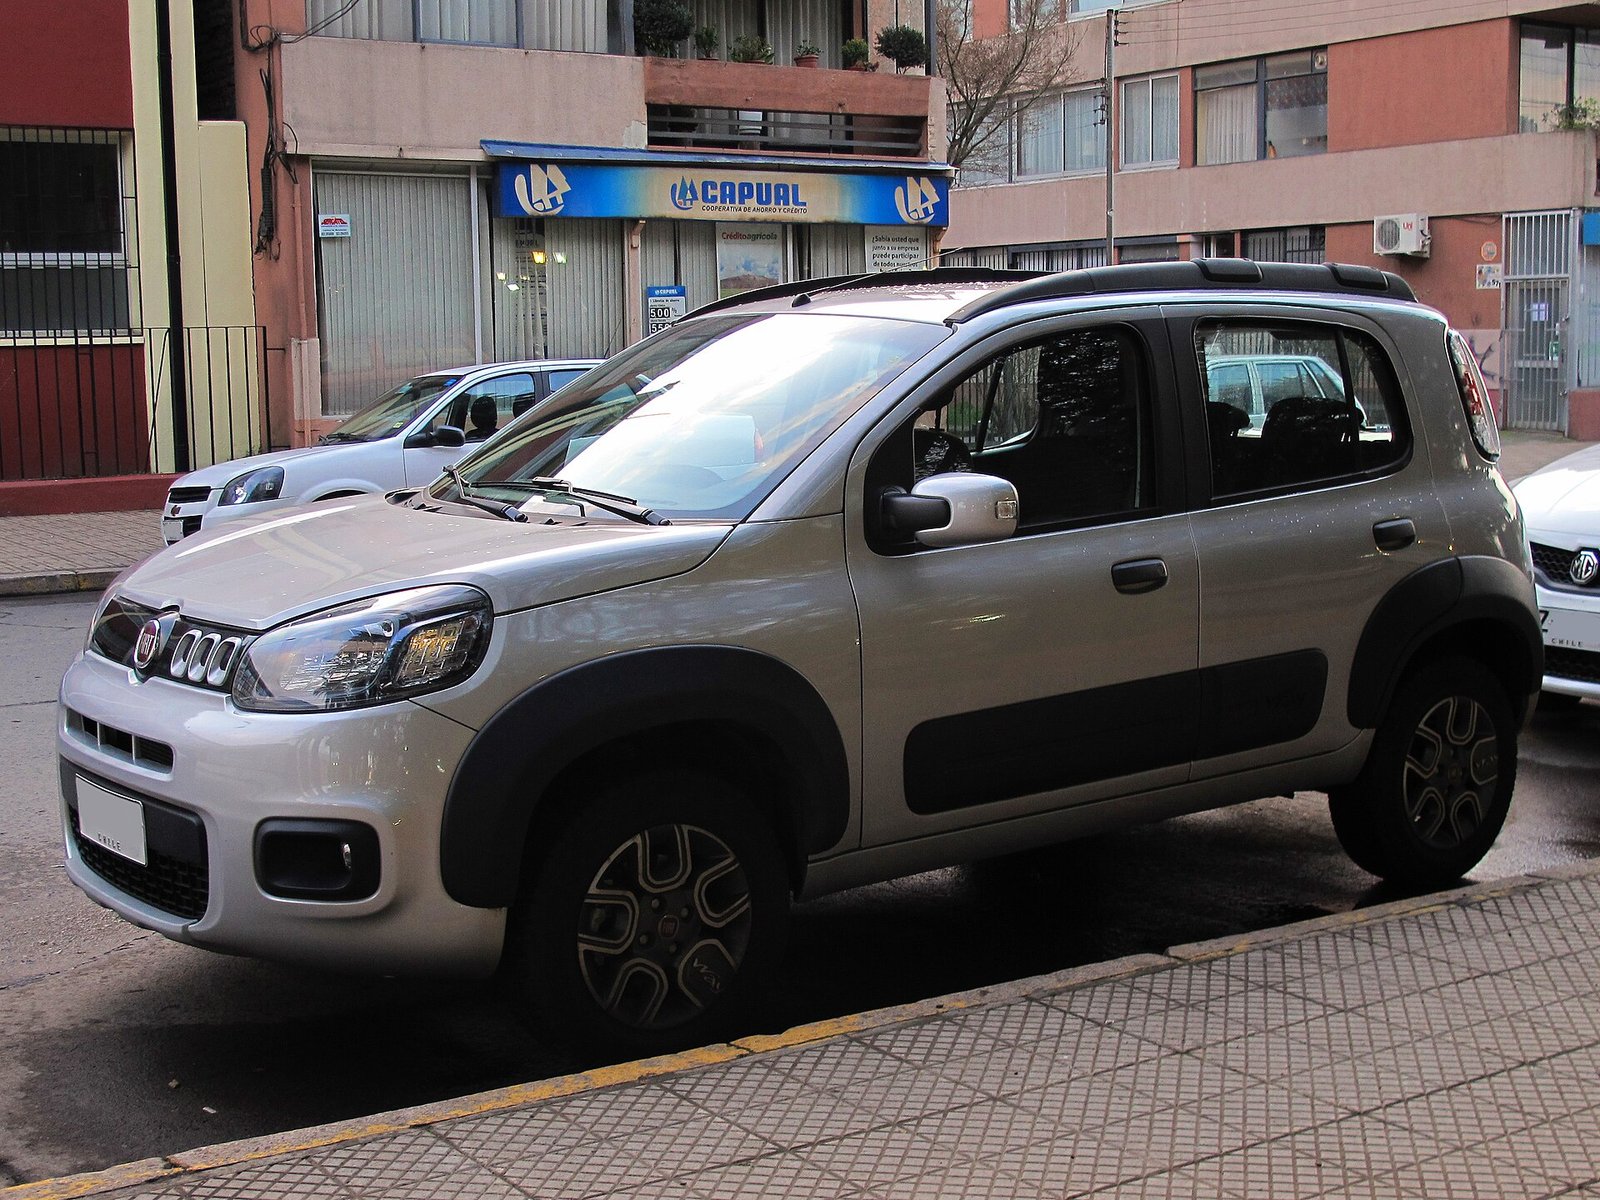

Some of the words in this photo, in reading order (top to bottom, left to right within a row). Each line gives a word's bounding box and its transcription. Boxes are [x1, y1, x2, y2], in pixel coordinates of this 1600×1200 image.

[701, 180, 807, 207] CAPUAL
[701, 204, 742, 213] COOPERATIVA
[752, 206, 777, 214] AHORRO
[782, 206, 808, 215] CRÉDITO
[891, 252, 919, 260] participar
[1572, 554, 1595, 579] MG
[1551, 637, 1585, 648] CHILE
